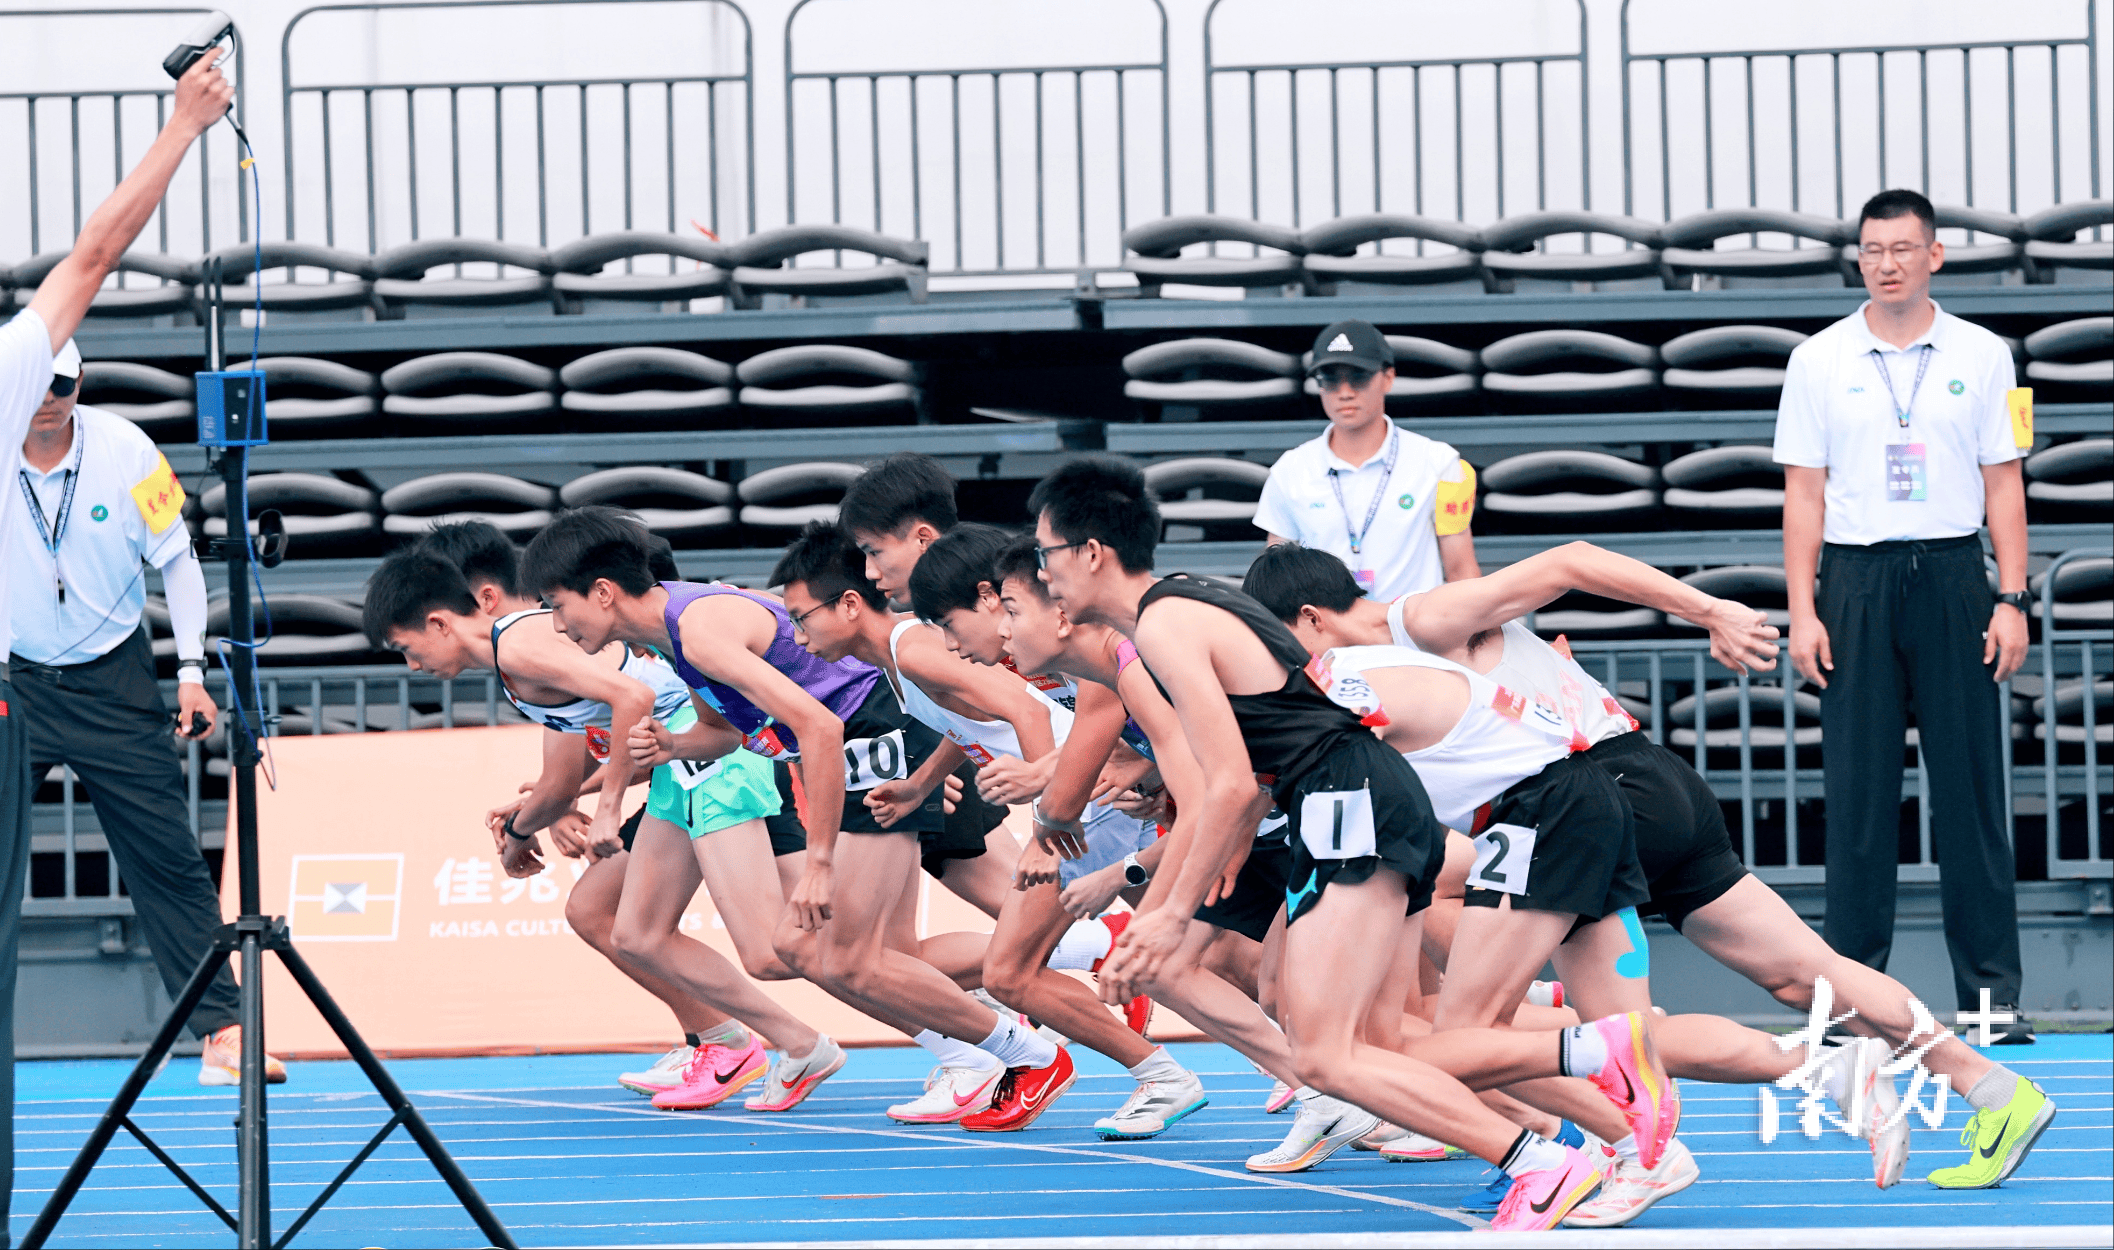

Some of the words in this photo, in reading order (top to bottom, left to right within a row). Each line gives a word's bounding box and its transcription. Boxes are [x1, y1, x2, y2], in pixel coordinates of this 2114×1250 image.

[844, 736, 899, 785] 10
[1332, 799, 1343, 851] 1
[433, 856, 591, 906] 佳兆
[1479, 830, 1511, 884] 2
[429, 921, 499, 938] KAISA
